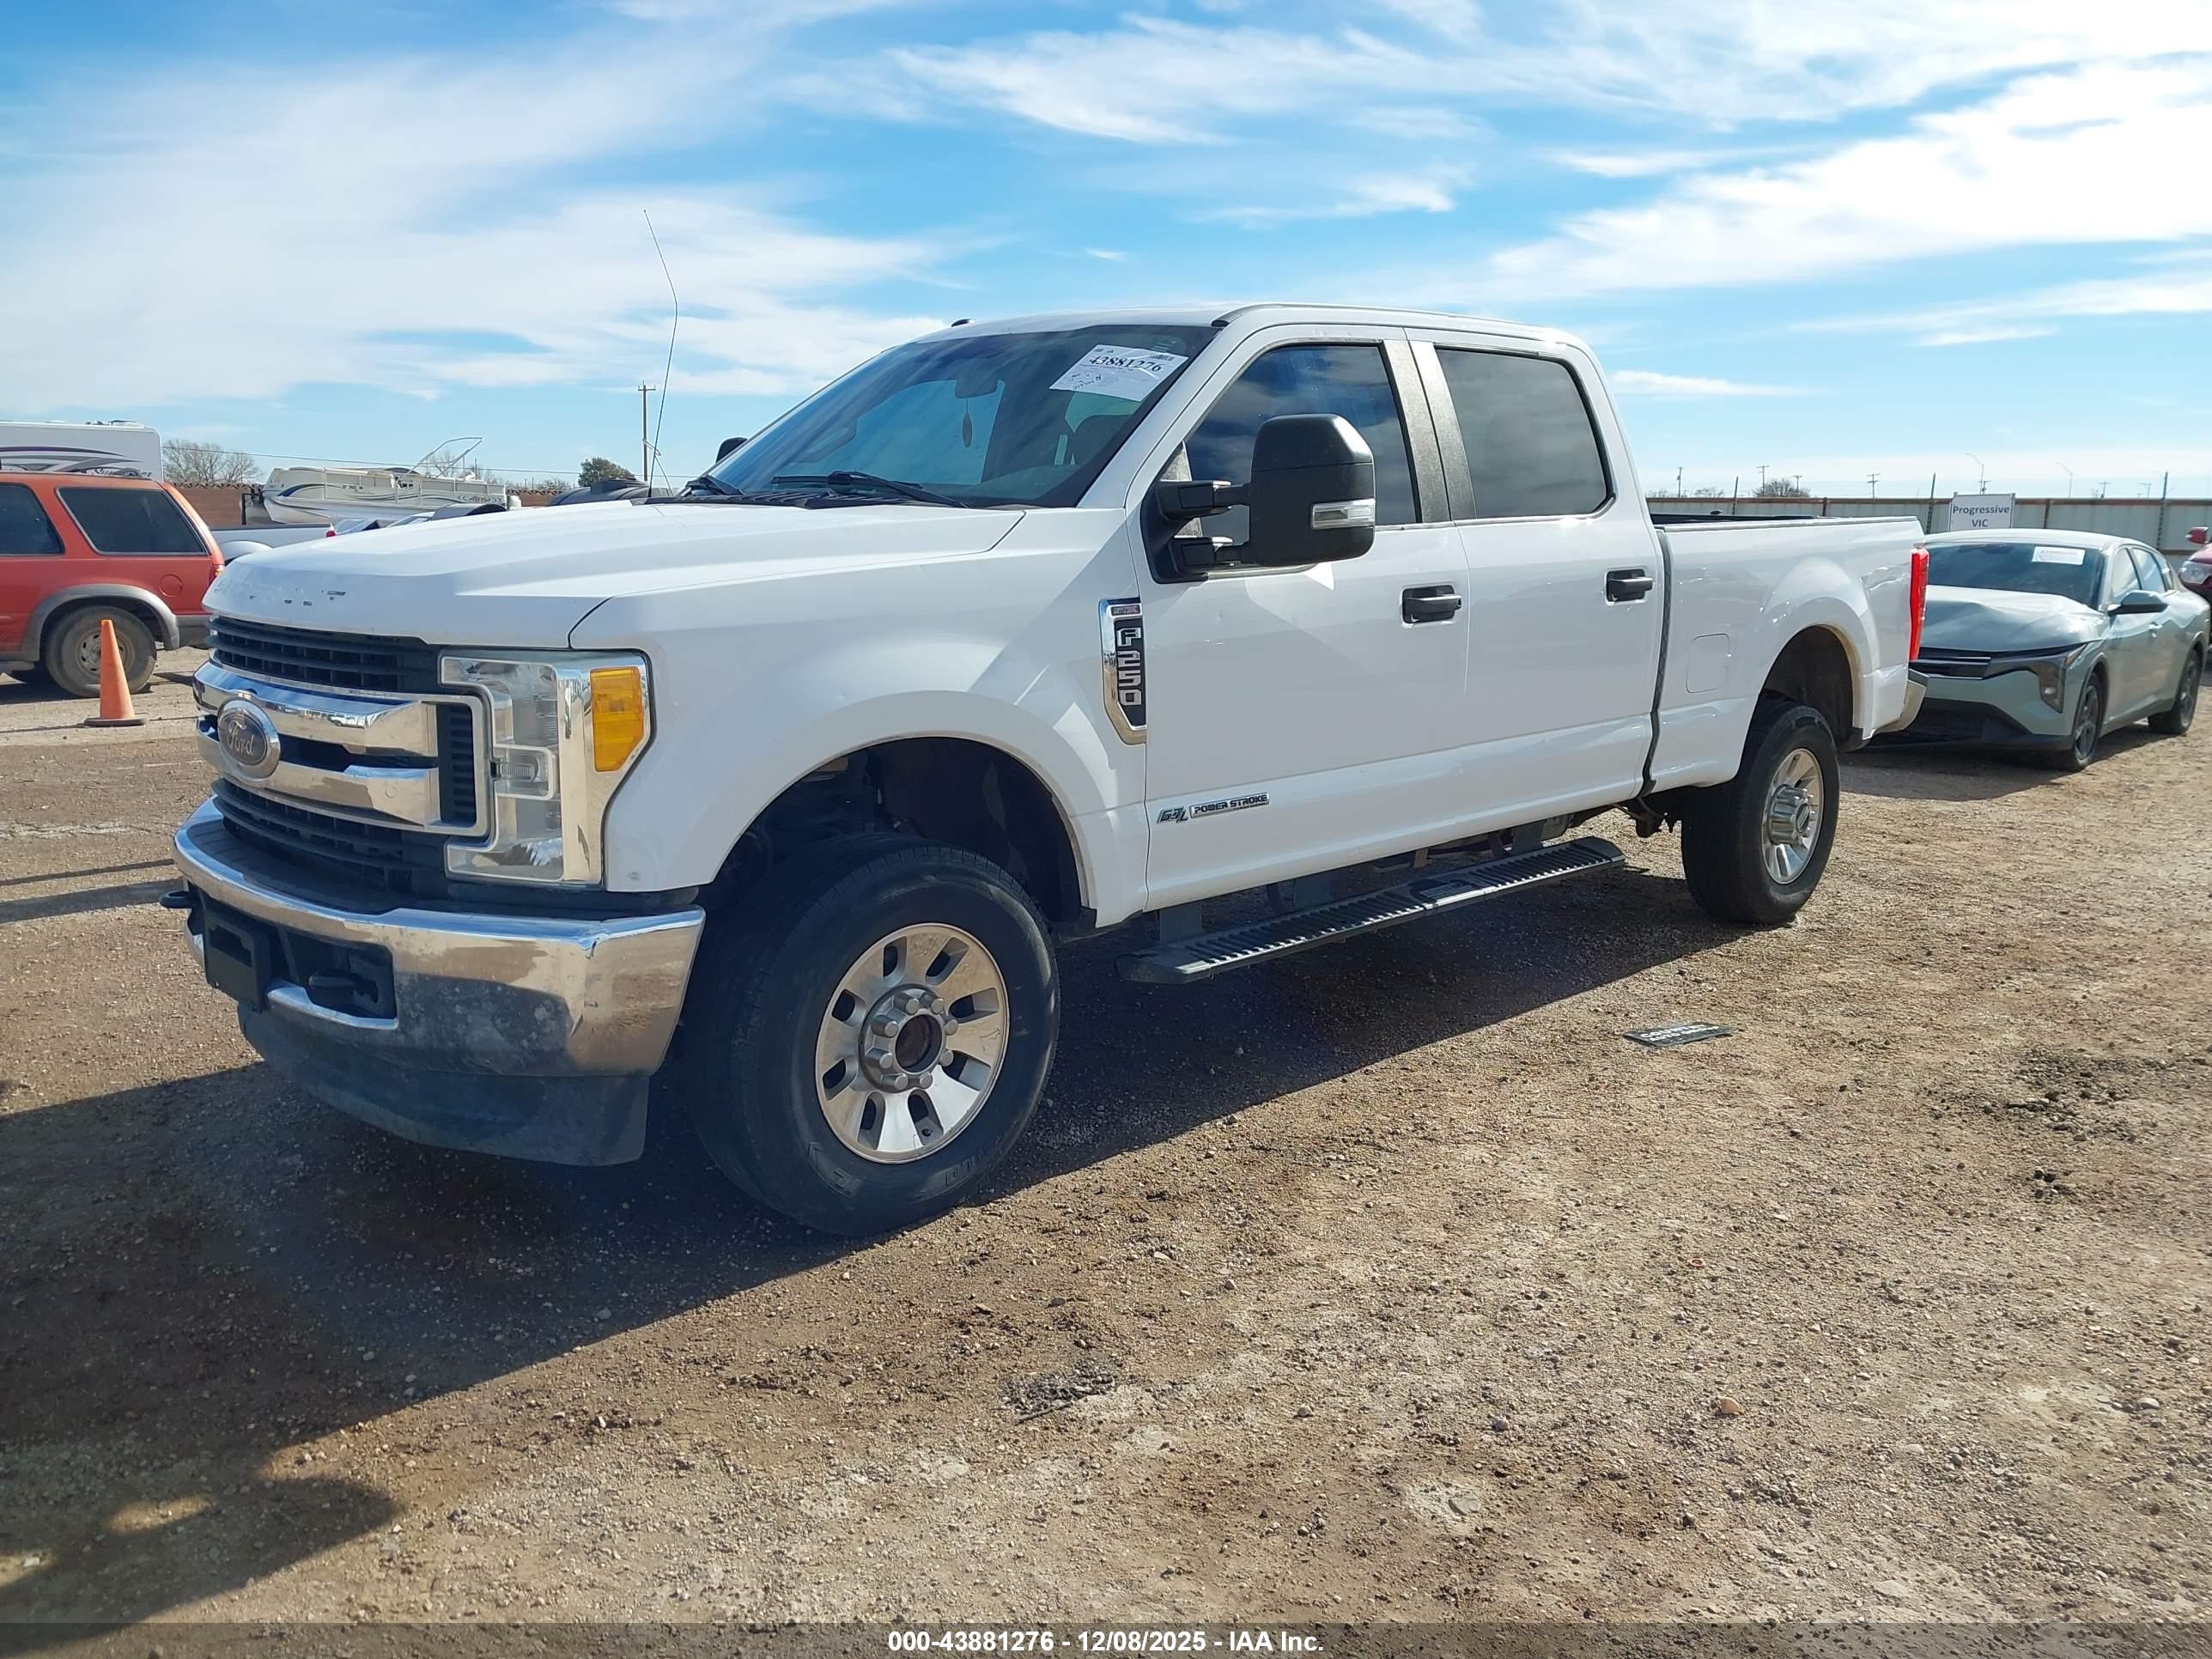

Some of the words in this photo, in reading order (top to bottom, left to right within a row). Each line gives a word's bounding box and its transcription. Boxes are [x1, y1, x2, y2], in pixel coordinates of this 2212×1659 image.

[1089, 356, 1163, 372] 43881276
[1953, 505, 2010, 515] Progressive
[1972, 519, 1990, 527] VIC
[227, 720, 256, 757] Ford
[1194, 802, 1228, 814] POWER
[1230, 794, 1267, 807] STROKE
